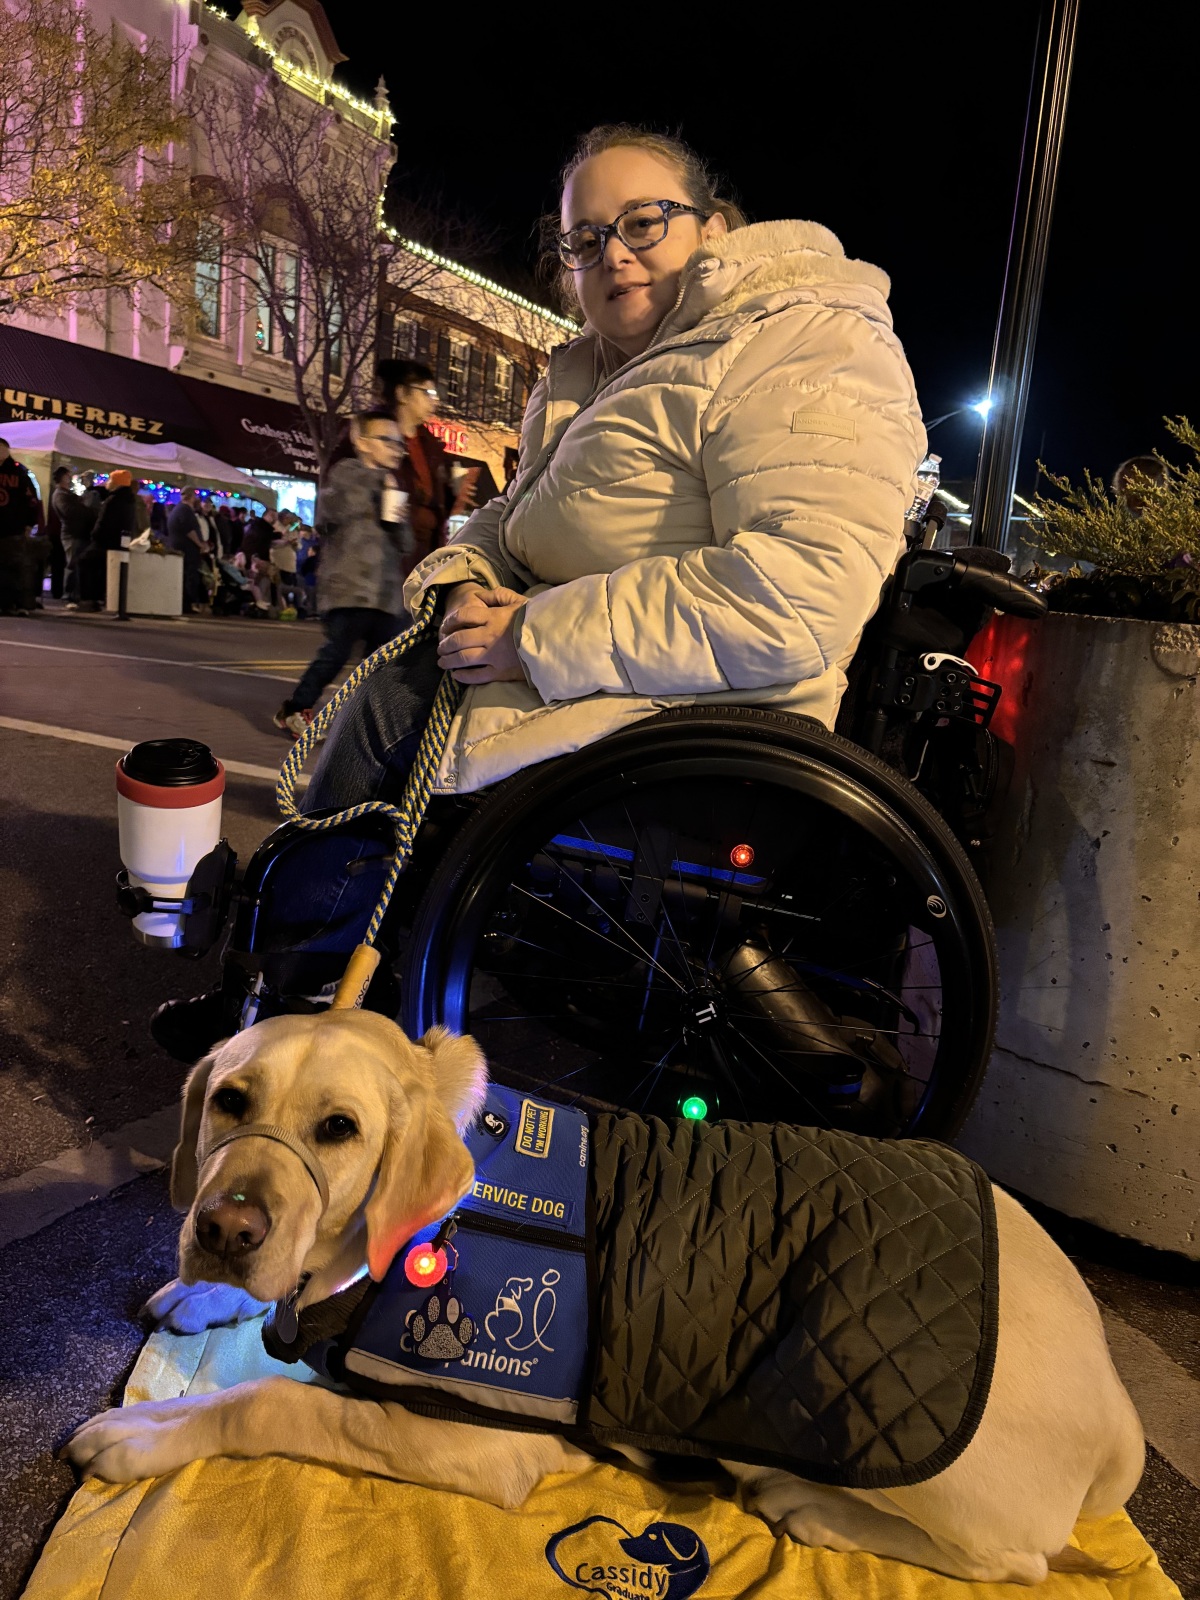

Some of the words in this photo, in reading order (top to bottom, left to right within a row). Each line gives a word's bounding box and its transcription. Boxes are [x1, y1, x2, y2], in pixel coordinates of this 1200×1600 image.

[0, 388, 163, 436] UTIERREZ
[525, 1118, 536, 1135] NOT
[527, 1106, 537, 1119] PET
[537, 1110, 549, 1138] WORKING
[522, 1136, 533, 1148] DO
[535, 1139, 545, 1151] I'M
[578, 1124, 589, 1168] canine.org
[472, 1180, 528, 1210] ERVICE
[531, 1197, 565, 1218] DOG
[575, 1562, 666, 1596] Cassidy
